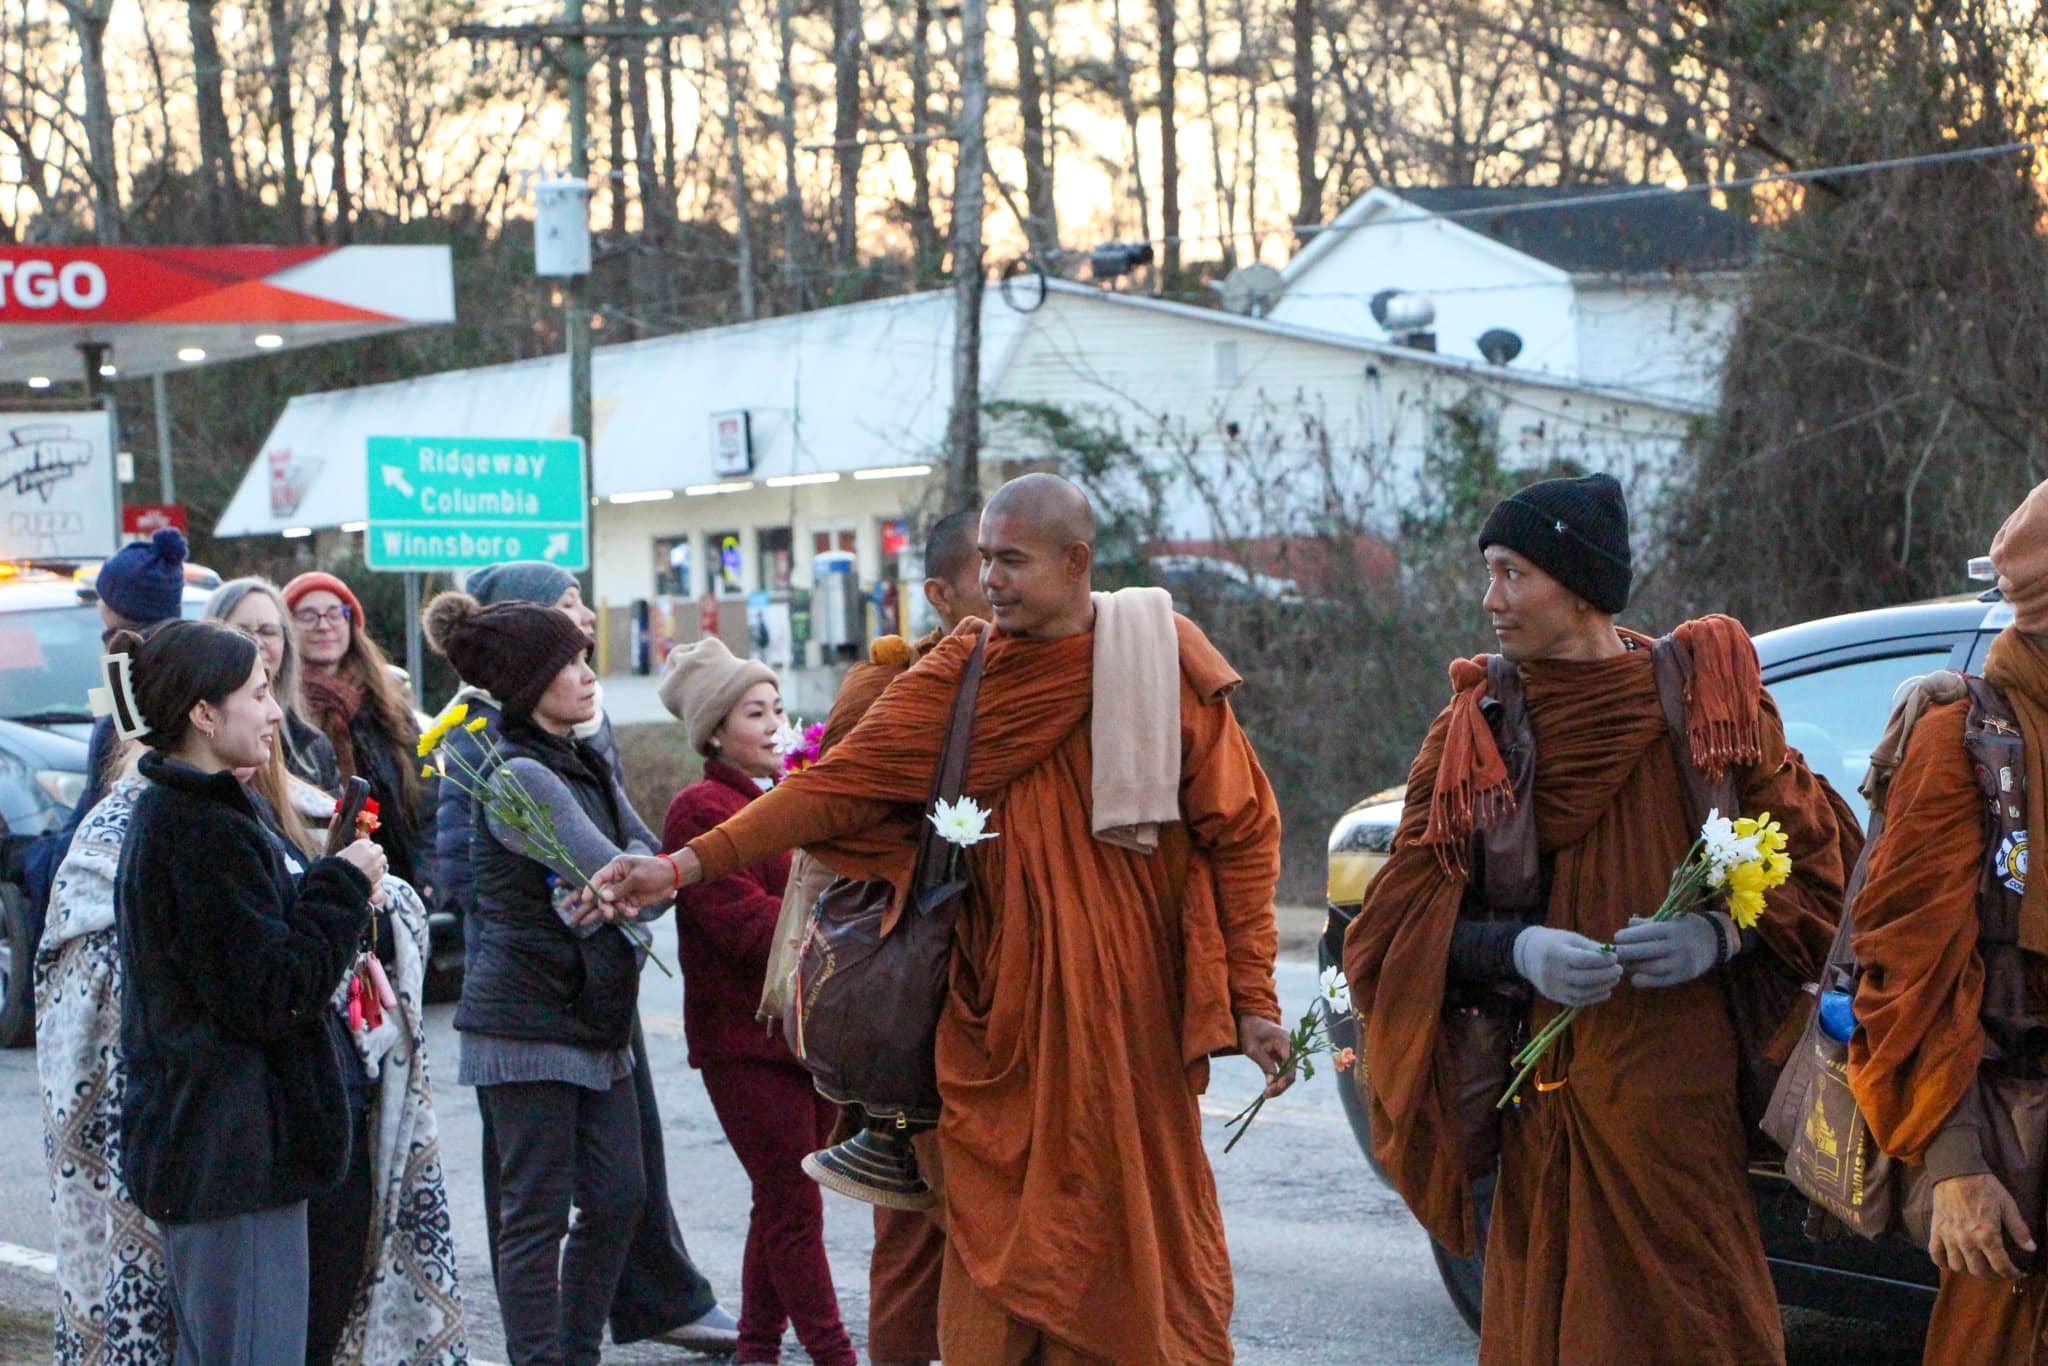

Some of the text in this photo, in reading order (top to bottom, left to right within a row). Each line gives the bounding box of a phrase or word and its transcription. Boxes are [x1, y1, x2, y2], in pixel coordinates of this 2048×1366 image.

[418, 446, 546, 480] Ridgeway
[420, 487, 540, 515] Columbia
[382, 531, 521, 557] Winnsboro
